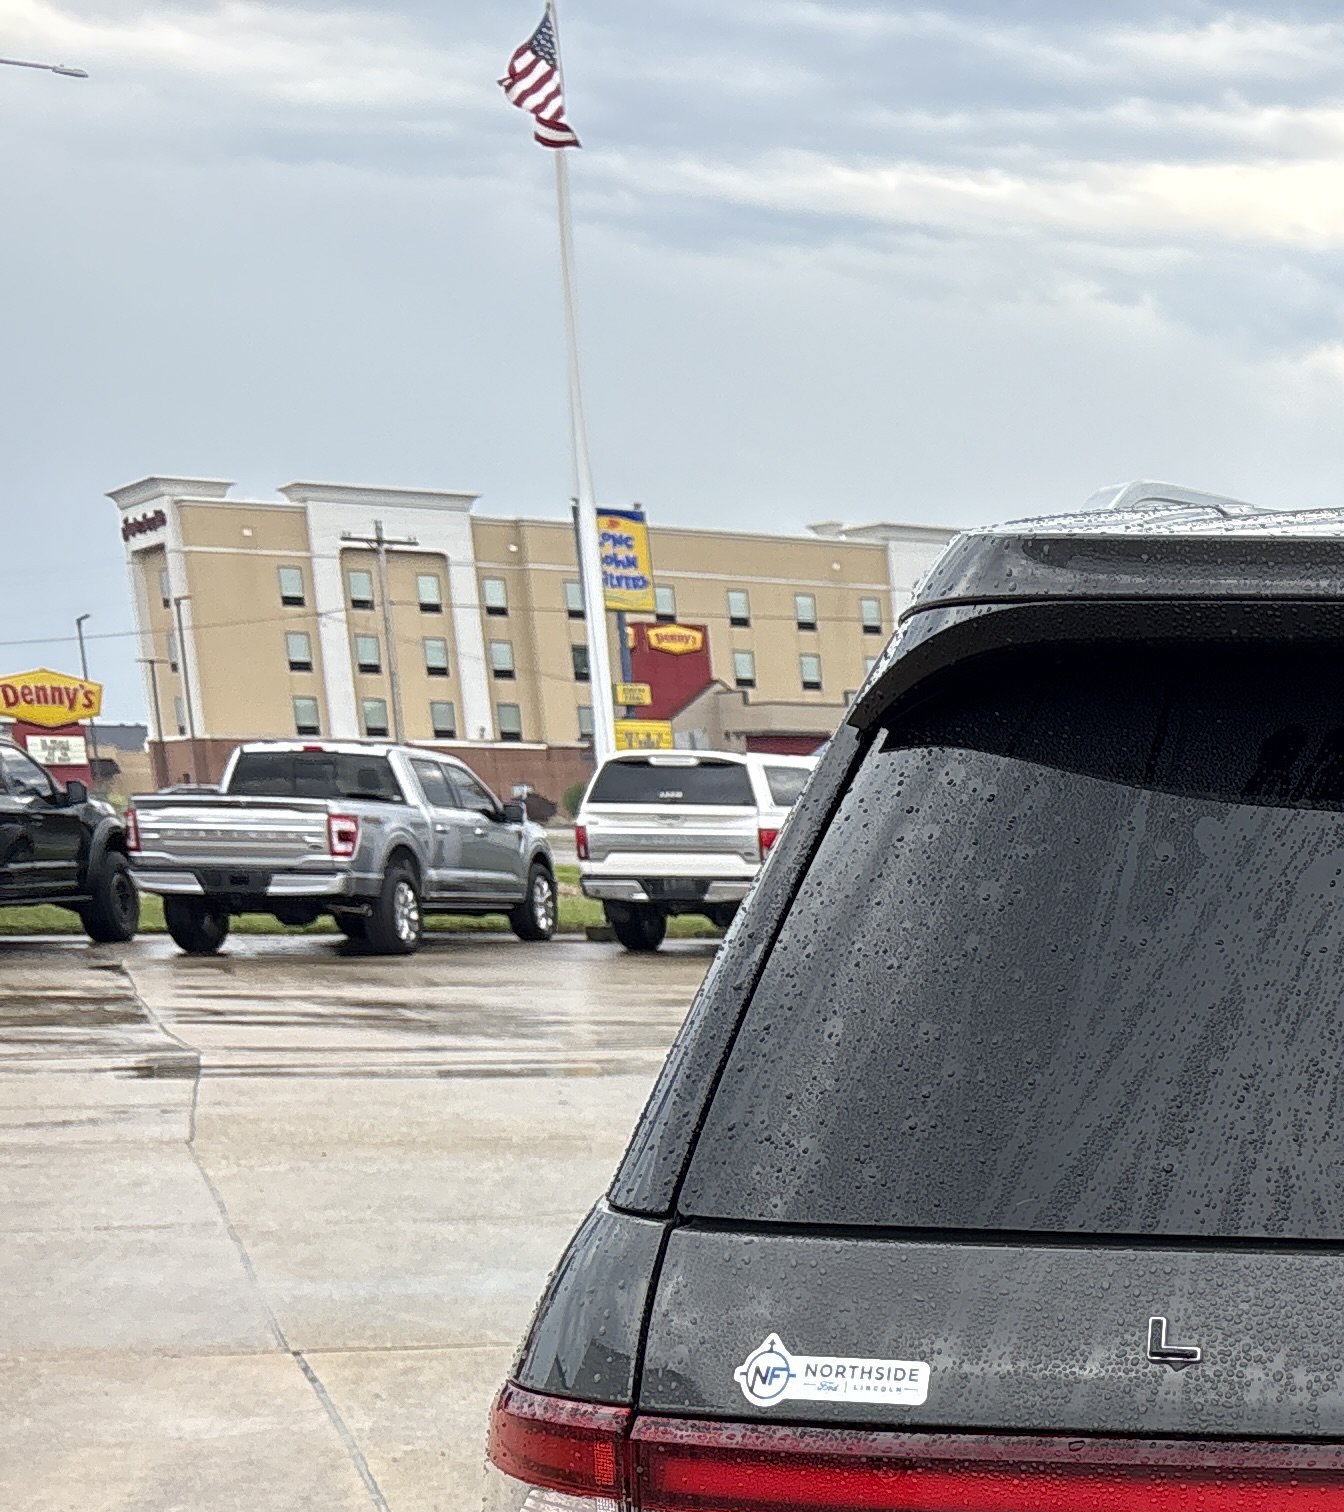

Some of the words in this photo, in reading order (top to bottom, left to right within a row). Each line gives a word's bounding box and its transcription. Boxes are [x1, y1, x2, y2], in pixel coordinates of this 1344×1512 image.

[0, 683, 95, 712] Denny's
[804, 1363, 920, 1382] NORTHSIDE
[853, 1384, 902, 1393] LINCOLN
